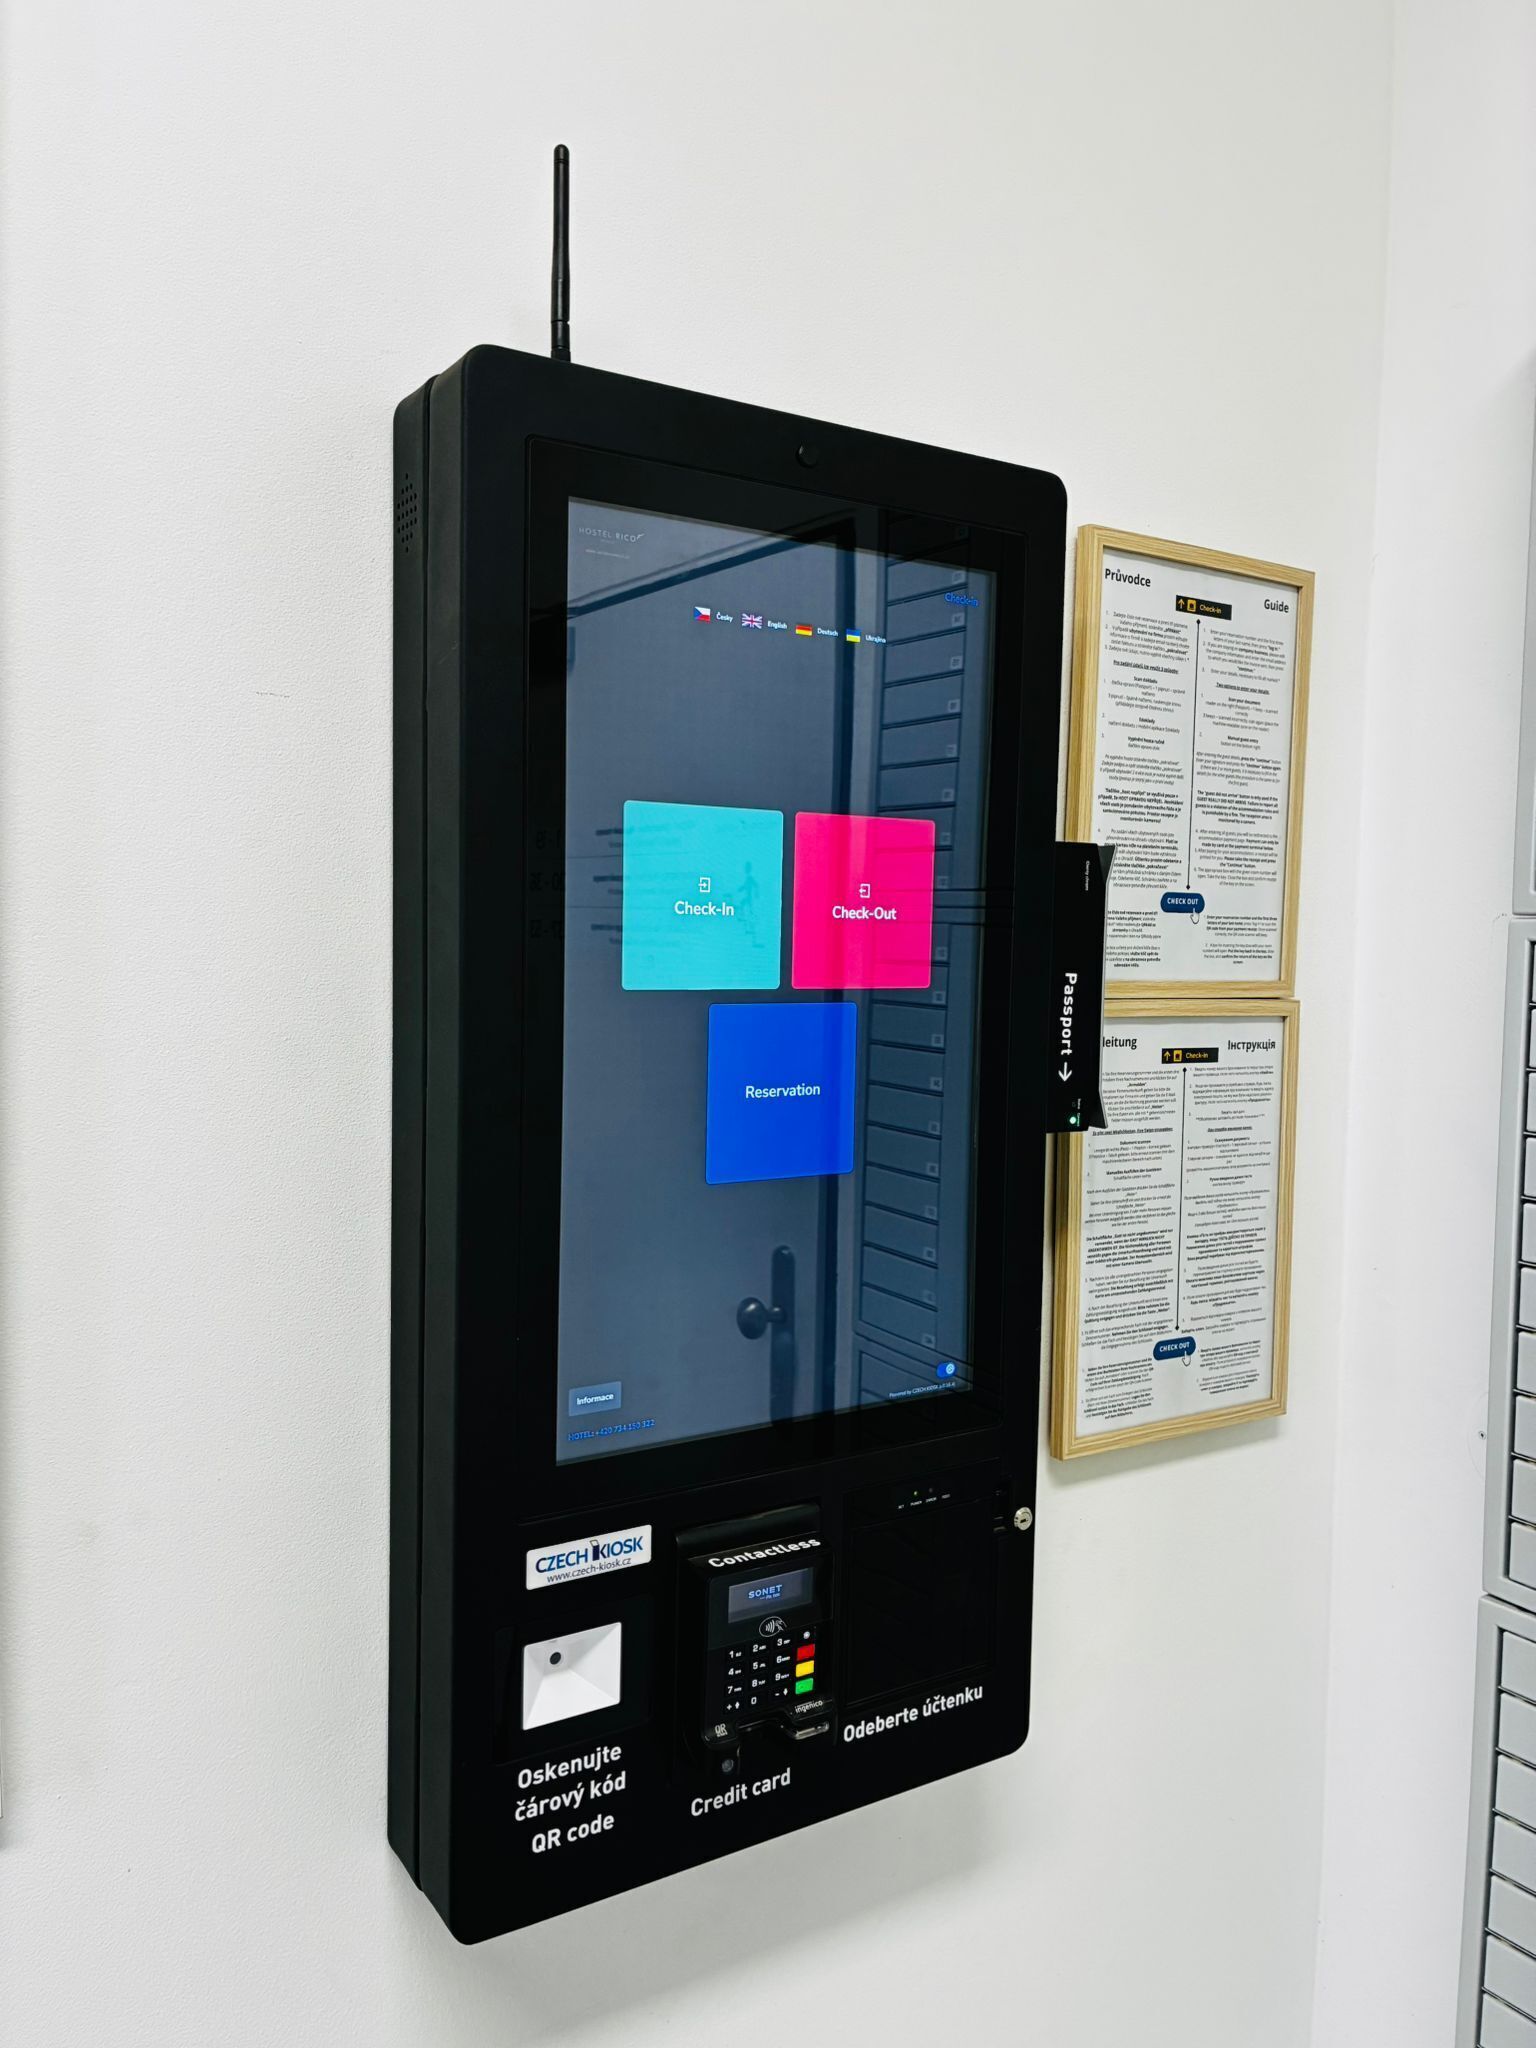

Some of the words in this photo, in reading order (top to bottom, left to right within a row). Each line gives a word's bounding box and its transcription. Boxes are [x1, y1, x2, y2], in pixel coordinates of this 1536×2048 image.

[578, 528, 612, 538] HOSTEL
[616, 532, 636, 542] RICO
[1104, 568, 1151, 588] Průvodce
[1200, 604, 1222, 614] Check-in
[1264, 598, 1290, 614] Guide
[716, 610, 734, 622] Česky
[767, 620, 788, 631] English
[816, 628, 839, 638] Deutsch
[674, 900, 735, 916] Check-In
[832, 906, 897, 920] Check-Out
[1060, 972, 1078, 1056] Passport
[1102, 1036, 1138, 1050] leitung
[1228, 1038, 1276, 1052] Інструкція
[1186, 1052, 1208, 1060] Check-in
[745, 1082, 820, 1099] Reservation
[1159, 1344, 1178, 1352] CHECK
[576, 1394, 614, 1406] Informace
[568, 1430, 594, 1441] HOTEL:
[536, 1548, 588, 1574] CZECH
[591, 1536, 644, 1561] KIOSK
[708, 1538, 821, 1568] Contactless
[546, 1557, 632, 1583] www.czech-kiosk.cz
[748, 1584, 783, 1599] SONET
[729, 1650, 734, 1658] 1
[728, 1686, 733, 1694] 7
[795, 1700, 823, 1713] ingenico
[844, 1708, 918, 1742] Odeberte
[922, 1686, 983, 1717] účtenku
[518, 1746, 622, 1790] Oskenujte
[514, 1784, 584, 1822] čárový
[590, 1771, 626, 1800] kód
[690, 1784, 748, 1816] Credit
[752, 1768, 791, 1796] card
[532, 1828, 561, 1854] QR
[566, 1814, 614, 1842] code
